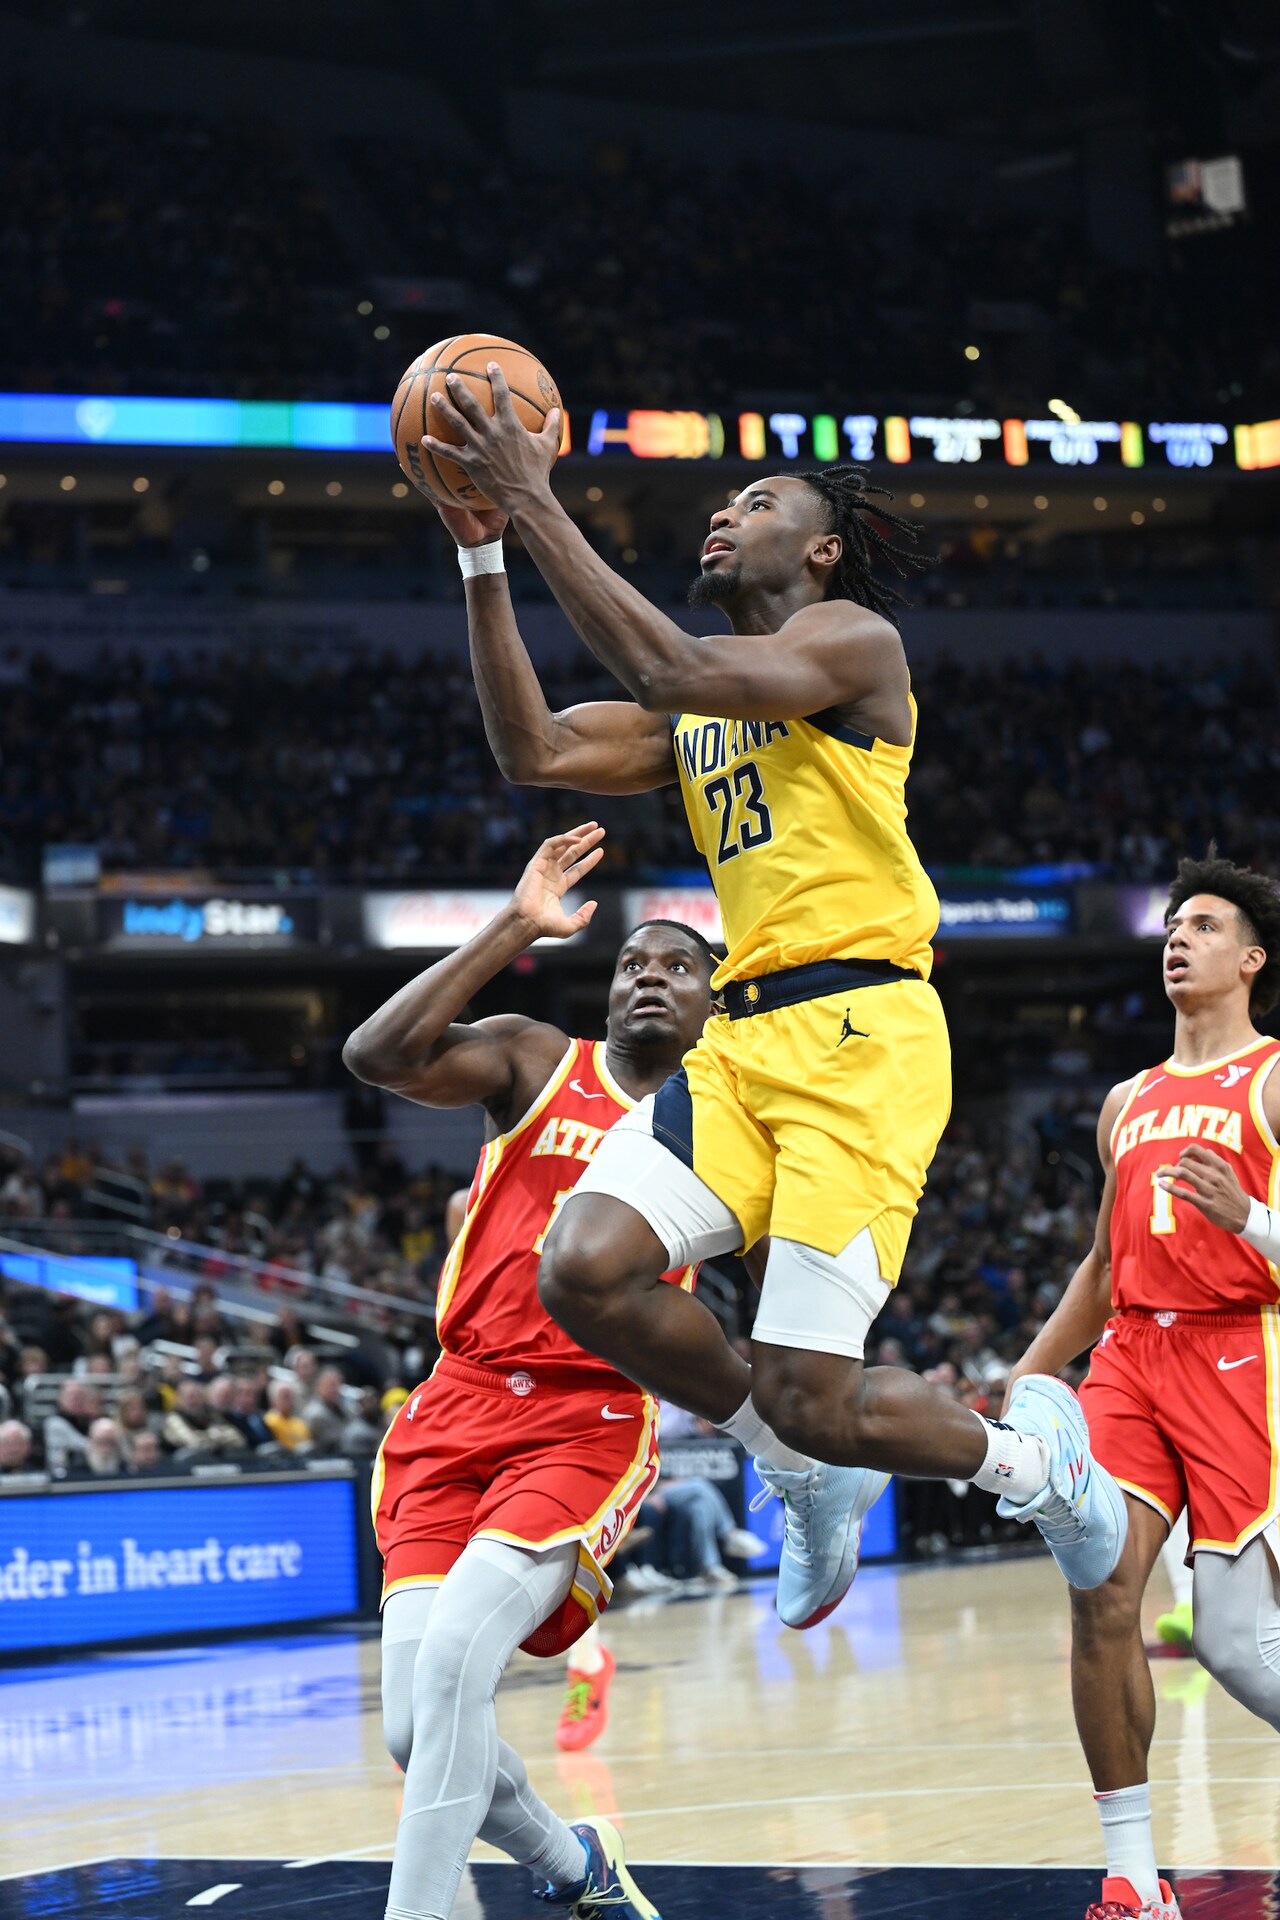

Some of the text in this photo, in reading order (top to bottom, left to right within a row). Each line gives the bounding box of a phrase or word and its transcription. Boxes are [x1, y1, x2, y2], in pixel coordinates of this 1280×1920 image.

[703, 760, 774, 867] 23
[530, 1117, 607, 1163] ATL
[1115, 1104, 1243, 1168] ATLANTA
[1150, 1164, 1176, 1235] 1
[505, 1377, 537, 1389] HAWKS
[0, 1537, 303, 1600] der in heart care
